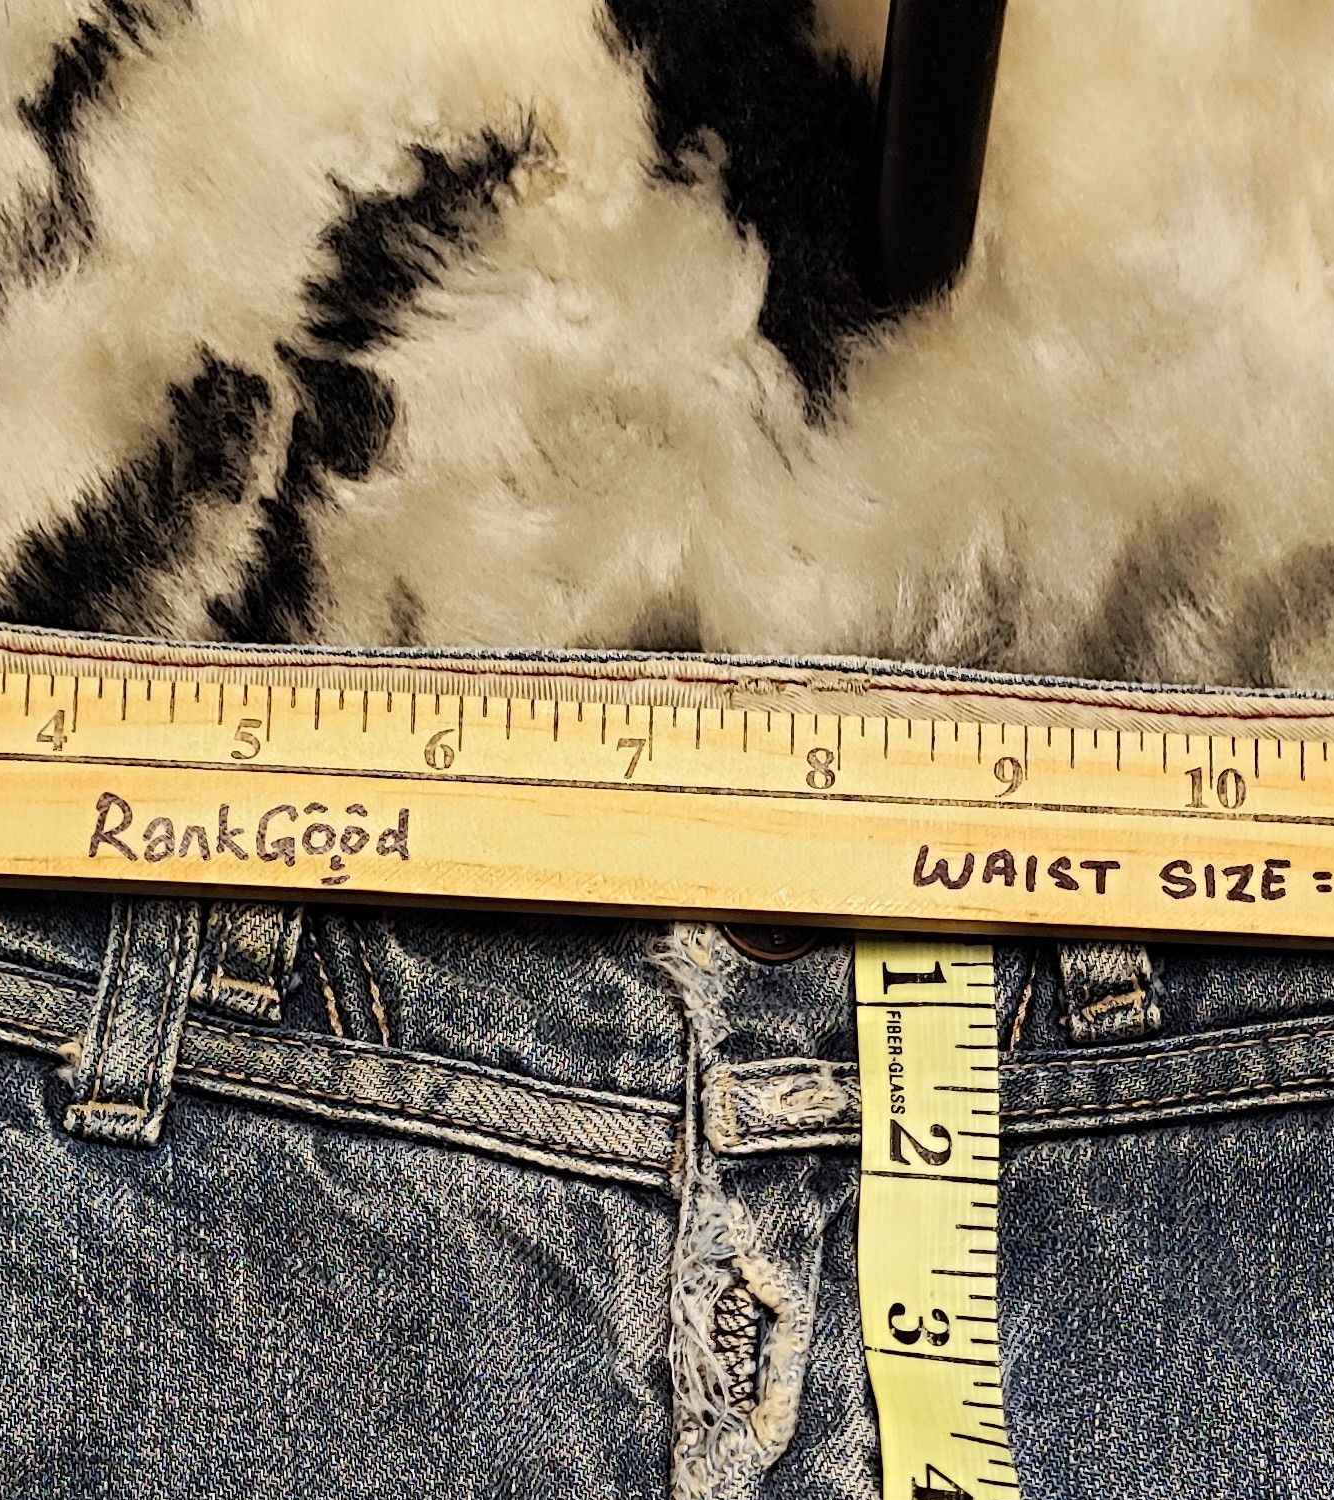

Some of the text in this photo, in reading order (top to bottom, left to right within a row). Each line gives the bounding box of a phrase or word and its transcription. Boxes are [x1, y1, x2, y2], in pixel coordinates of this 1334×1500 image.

[36, 710, 67, 751] 4
[231, 719, 262, 760] 5
[424, 729, 455, 771] 6
[617, 738, 647, 780] 7
[806, 747, 836, 790] 8
[994, 756, 1024, 798] 9
[1185, 767, 1247, 810] 10
[914, 845, 1120, 895] WAIST
[882, 961, 947, 995] 1
[886, 1010, 906, 1115] FIBER-GLASS
[889, 1119, 952, 1167] 2
[887, 1302, 950, 1347] 3
